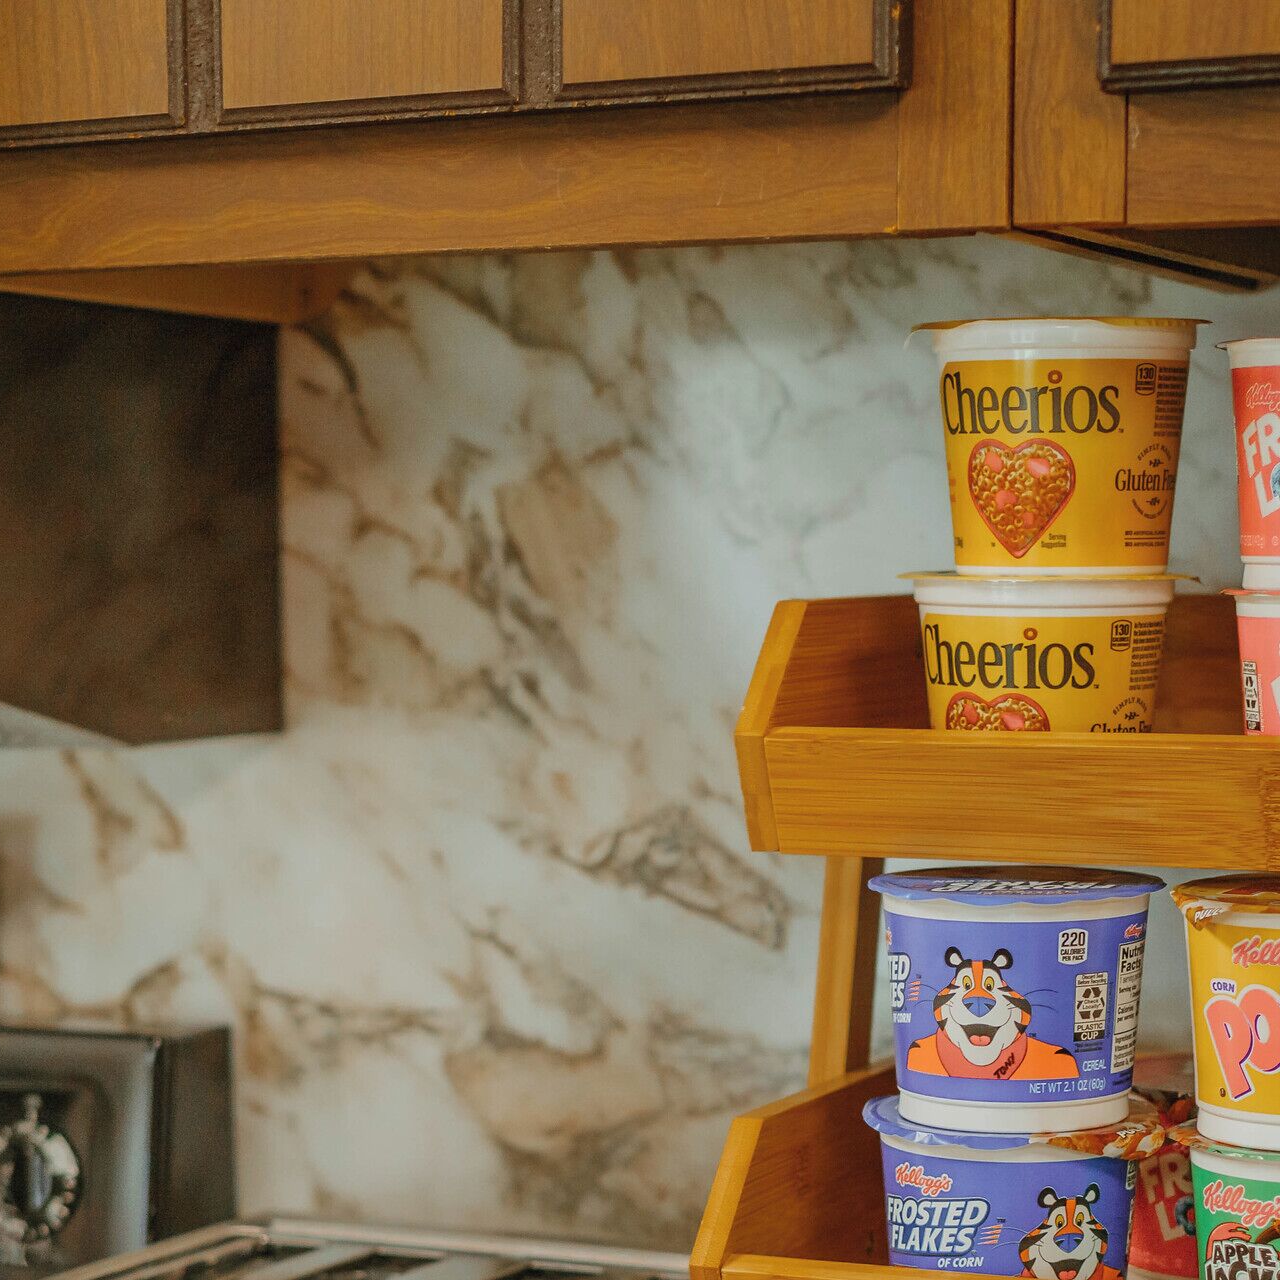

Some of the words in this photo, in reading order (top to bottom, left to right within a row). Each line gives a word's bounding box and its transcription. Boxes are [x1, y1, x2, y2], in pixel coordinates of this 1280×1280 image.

[942, 370, 1120, 435] Cheerios
[1115, 468, 1161, 492] Gluten
[1114, 624, 1130, 636] 130
[923, 625, 1096, 690] Cheerios
[1195, 908, 1222, 922] PULL
[1061, 931, 1086, 947] 220
[1060, 948, 1086, 956] CALORIES
[1212, 982, 1235, 993] CORN
[1077, 1023, 1104, 1031] PLASTIC
[1081, 1032, 1099, 1041] CUP
[993, 1052, 1016, 1080] TONY
[1082, 1059, 1106, 1072] CEREAL
[1029, 1082, 1046, 1094] NET
[1047, 1082, 1061, 1093] WT
[1062, 1081, 1075, 1093] 2.1
[895, 1162, 952, 1196] Kellogg's
[888, 1199, 988, 1227] FROSTED
[891, 1226, 974, 1253] FLAKES
[937, 1258, 951, 1268] OF
[953, 1256, 984, 1268] CORN
[1214, 1243, 1275, 1268] APPLE
